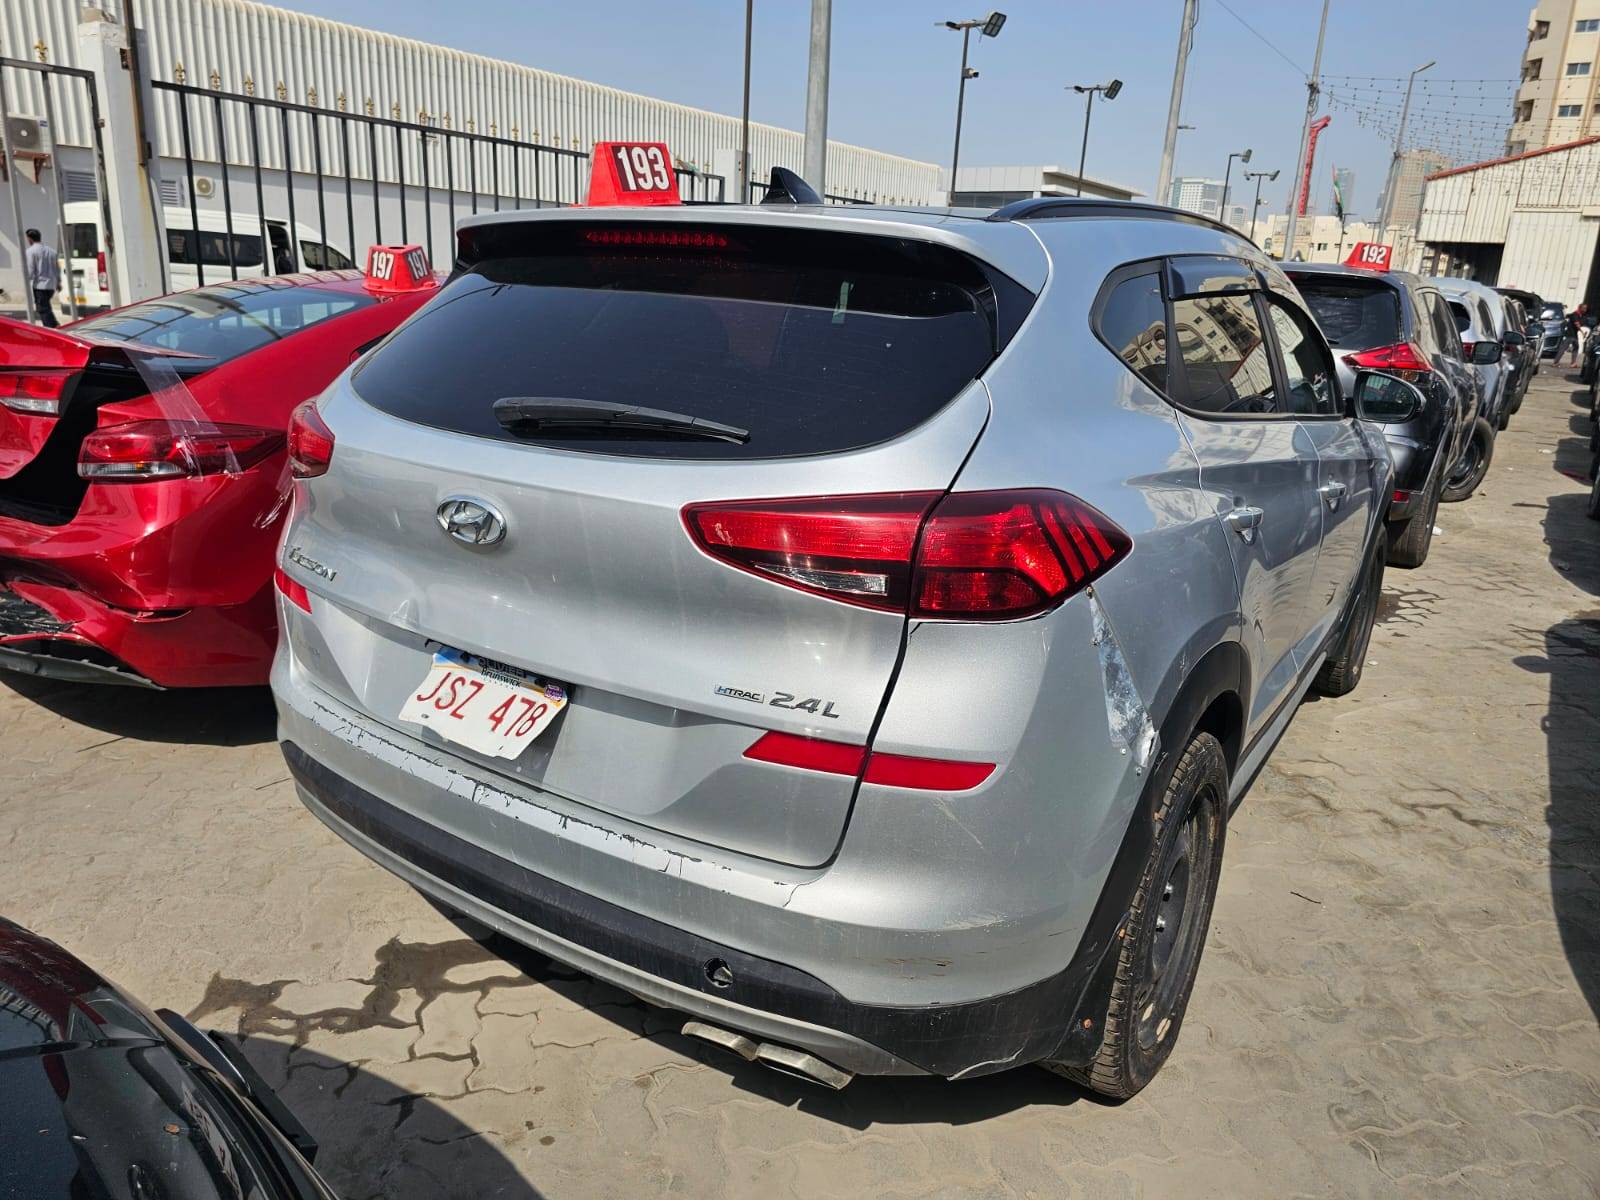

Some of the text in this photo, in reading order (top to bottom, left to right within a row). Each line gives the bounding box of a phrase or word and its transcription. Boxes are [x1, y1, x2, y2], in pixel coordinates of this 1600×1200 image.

[617, 146, 670, 191] 193
[372, 250, 395, 281] 197
[407, 249, 429, 280] 197
[1361, 244, 1387, 265] 192
[416, 671, 549, 738] JSZ 478
[717, 685, 762, 701] HTRAC
